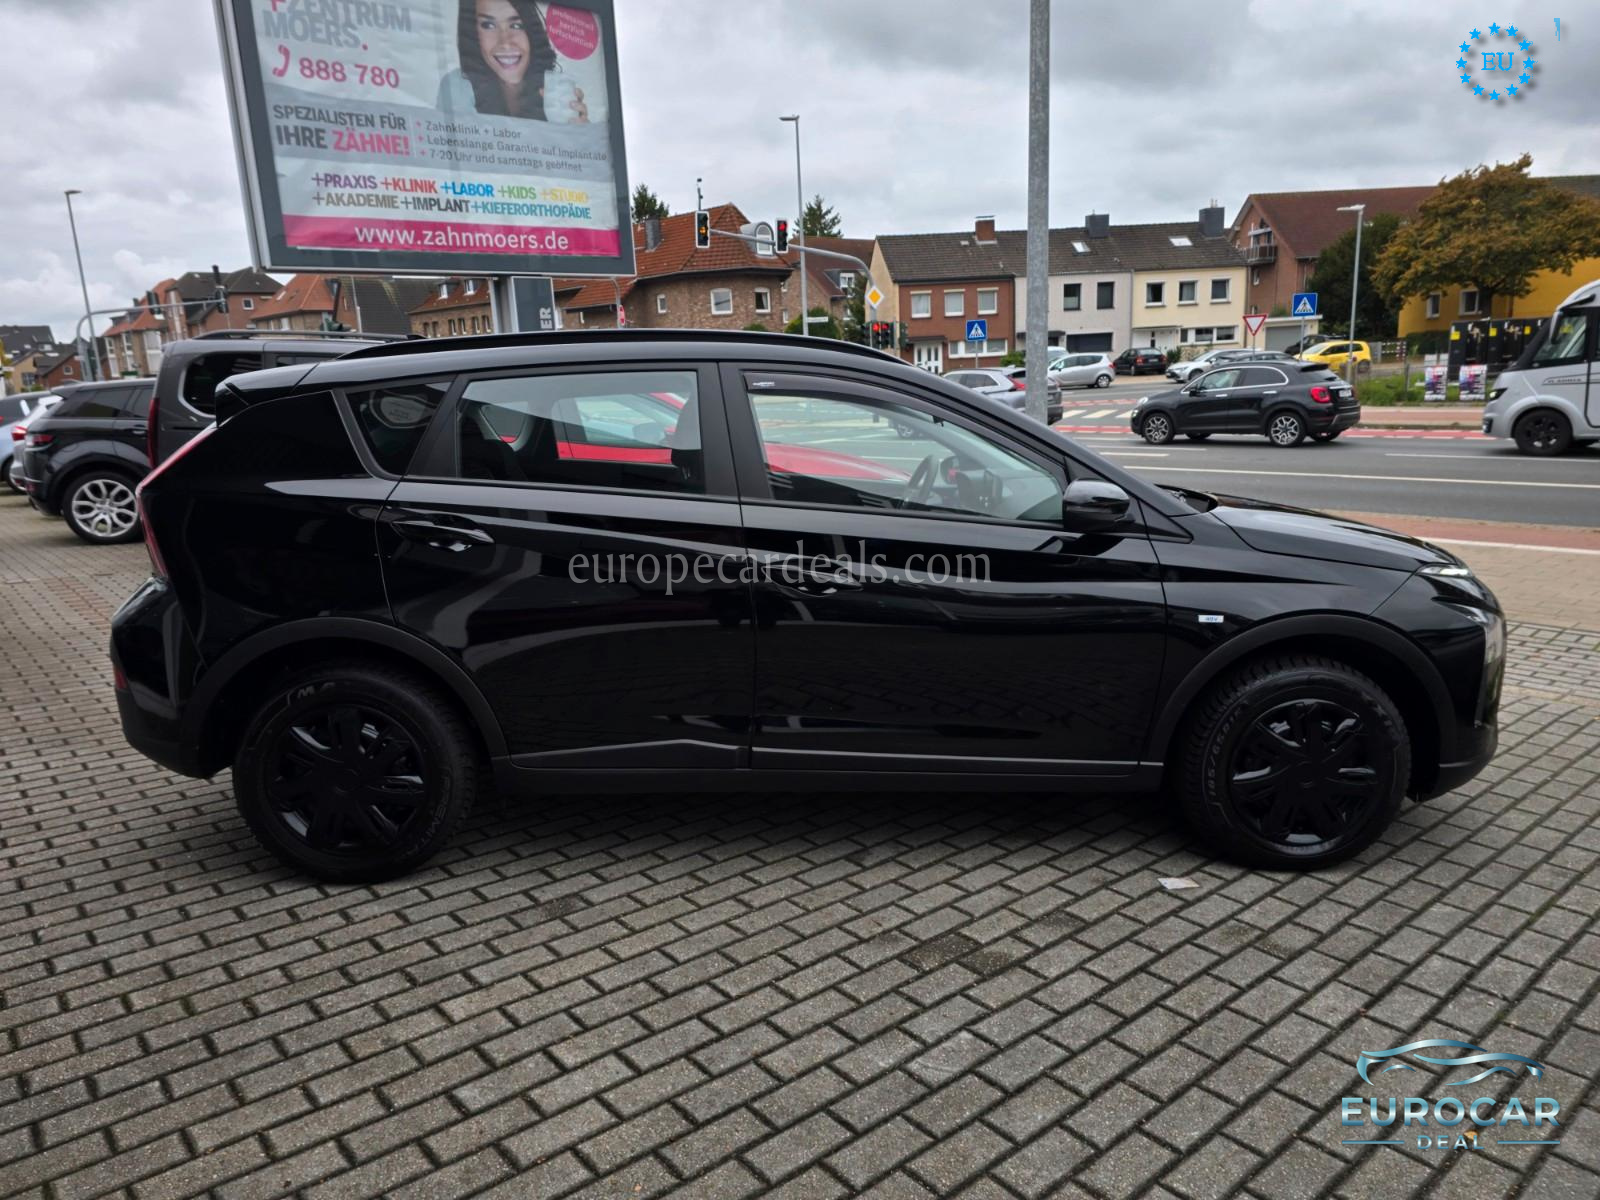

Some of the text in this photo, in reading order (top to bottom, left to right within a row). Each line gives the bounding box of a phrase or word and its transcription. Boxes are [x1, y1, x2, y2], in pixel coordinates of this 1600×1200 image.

[299, 57, 400, 88] 888 780
[273, 104, 407, 130] SPEZIALISTEN FÜR
[275, 125, 411, 156] IHRE ZÄHNE!
[425, 120, 480, 135] Zahnklinik
[492, 127, 522, 139] Labor
[426, 135, 494, 151] Lebenslange
[496, 140, 540, 154] Garantie
[541, 146, 556, 156] auf
[455, 151, 473, 162] Uhr
[475, 153, 496, 164] und
[311, 172, 378, 190] +PRAXIS
[380, 176, 438, 193] +KLINIK
[440, 181, 495, 198] +LABOR
[497, 184, 537, 200] +KIDS
[311, 192, 400, 209] +AKADEMIE
[400, 196, 470, 213] +IMPLANT
[355, 226, 569, 250] www.zahnmoers.de
